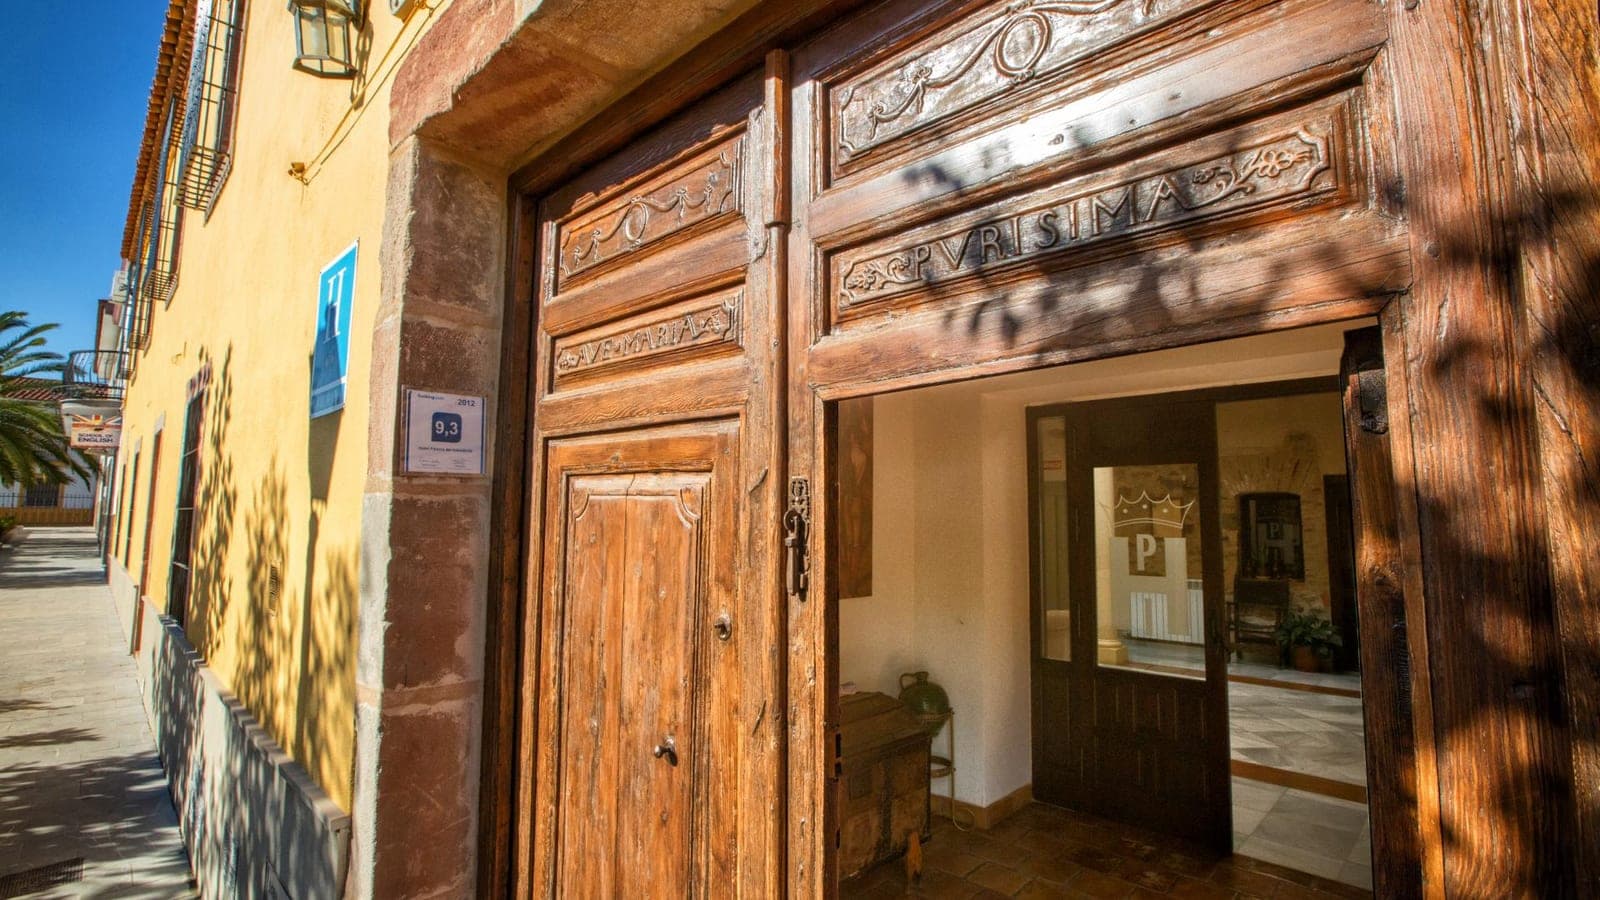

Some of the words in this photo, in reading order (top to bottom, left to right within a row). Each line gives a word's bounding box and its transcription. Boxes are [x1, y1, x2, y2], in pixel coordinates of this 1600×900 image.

[914, 174, 1188, 281] PVRISIMA
[324, 267, 347, 345] H
[457, 399, 476, 407] 2012
[435, 420, 458, 437] 9,3
[1136, 533, 1157, 571] P
